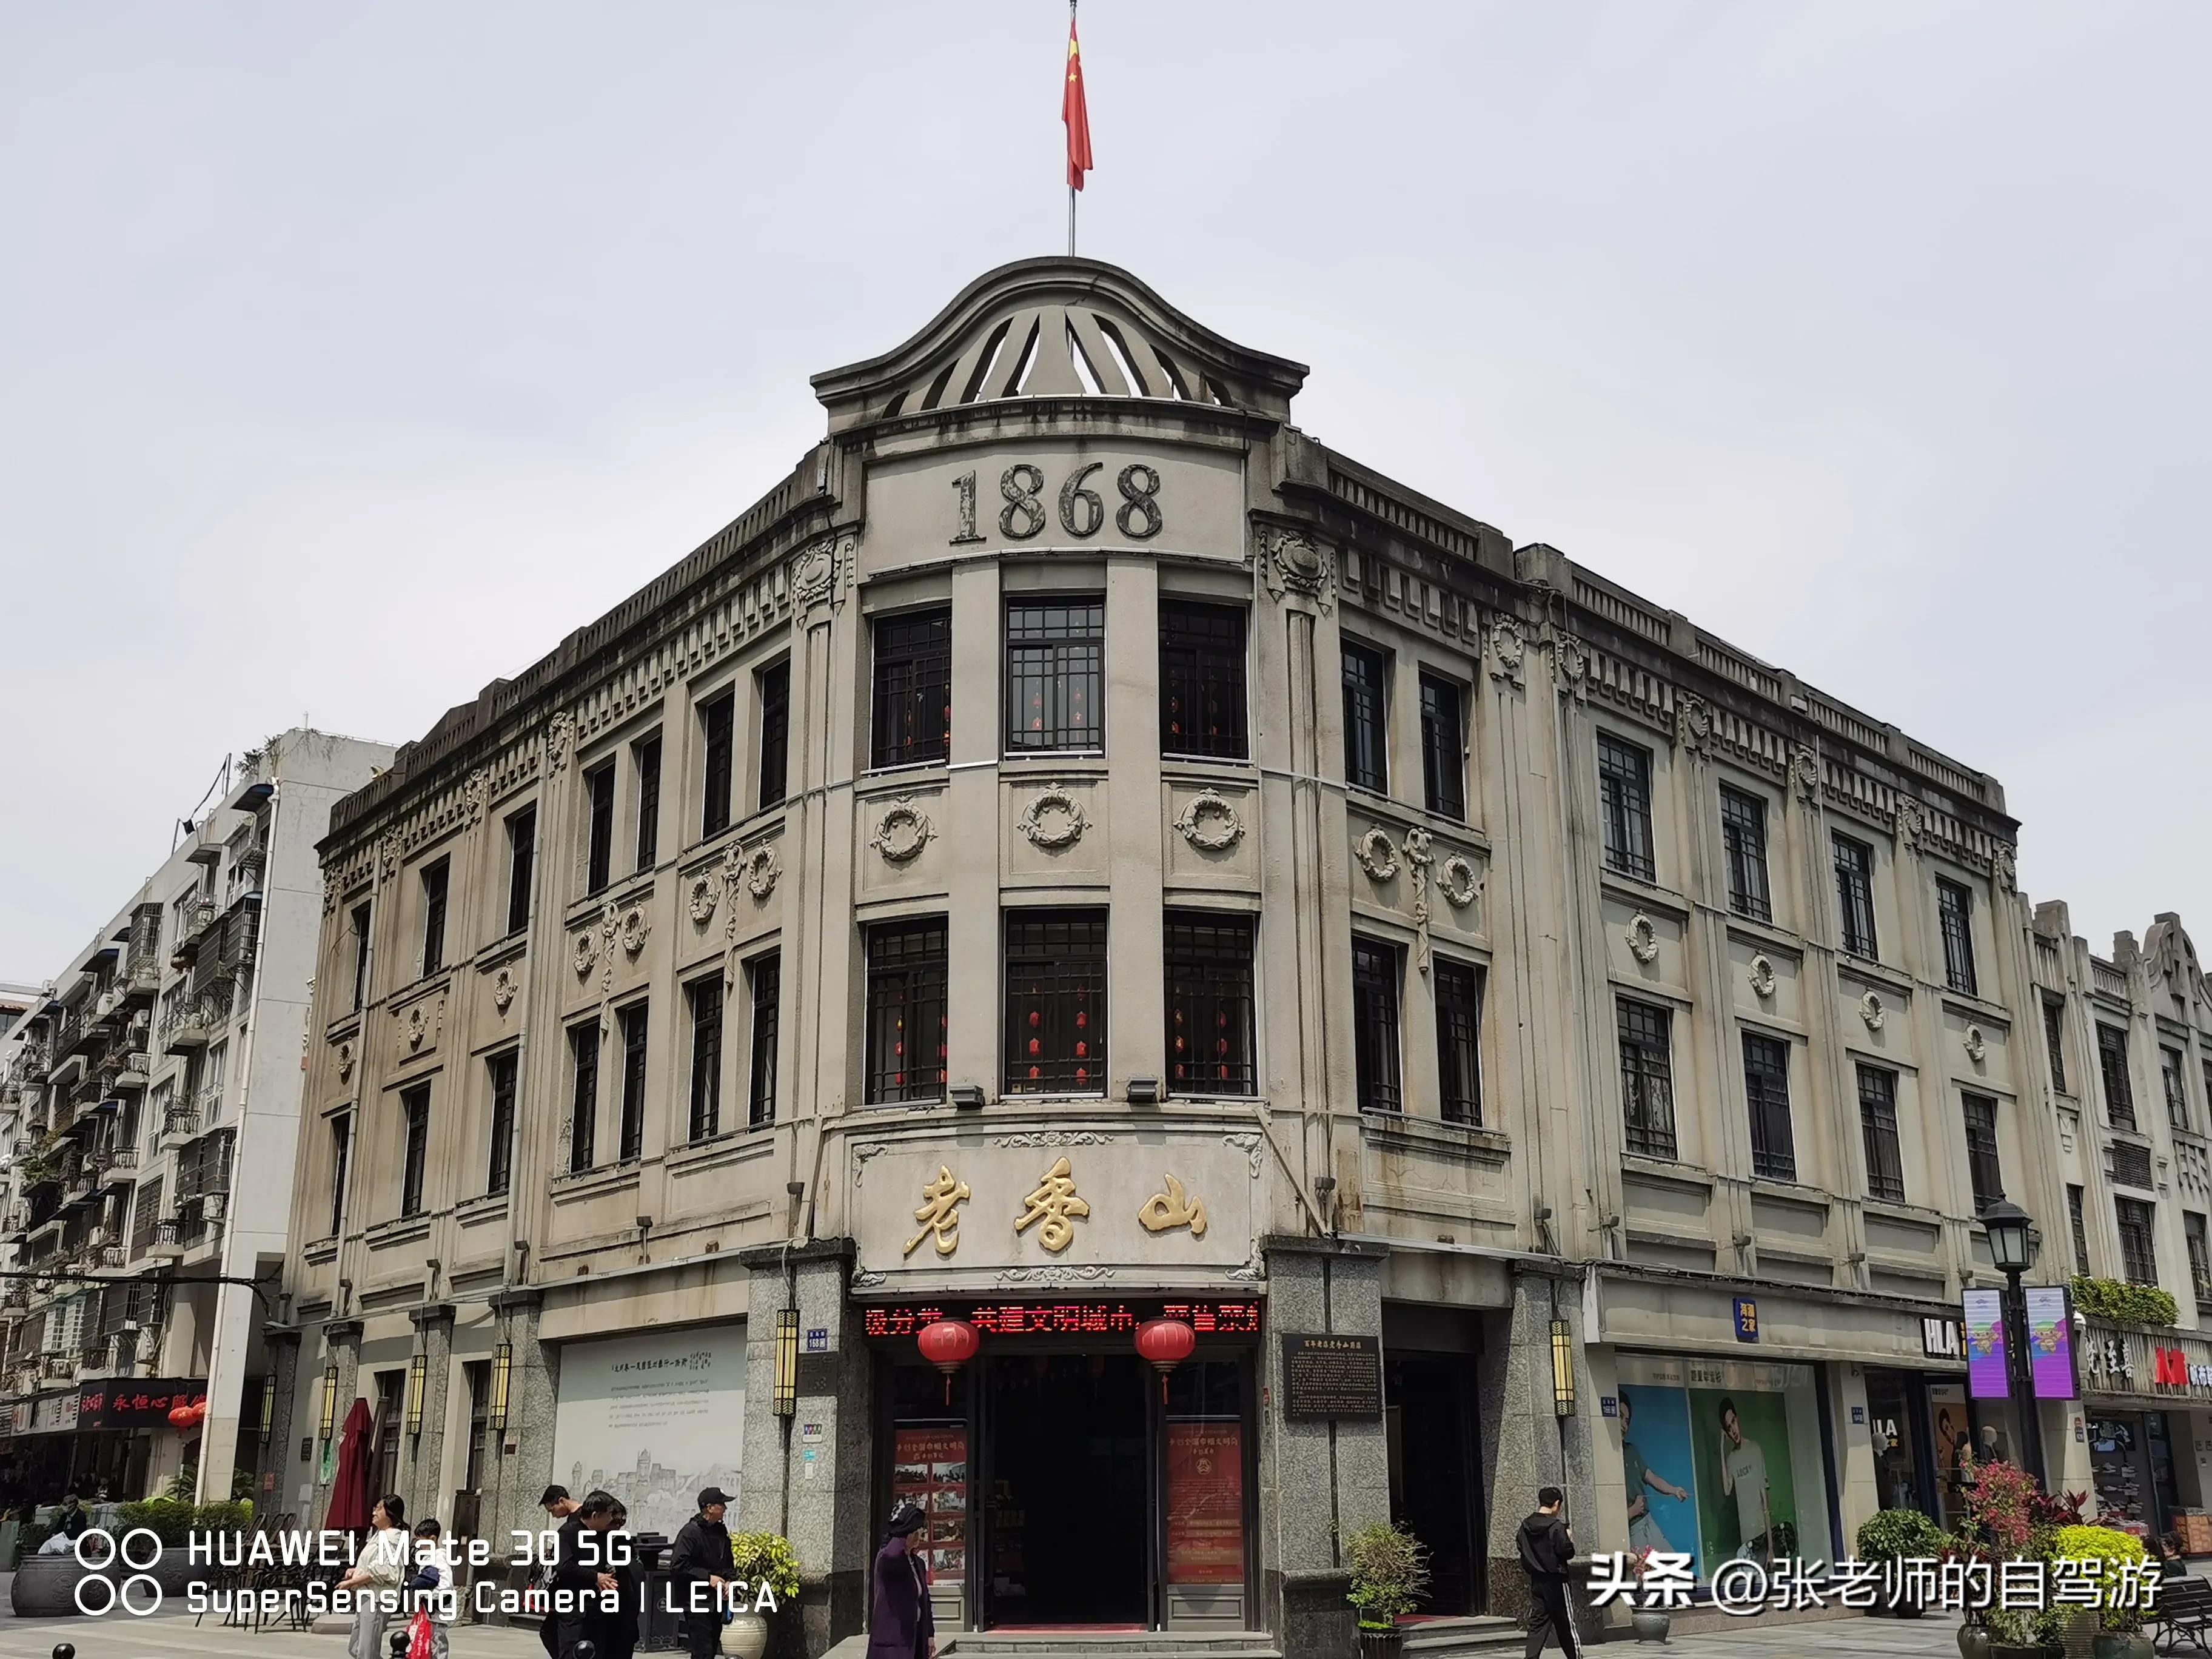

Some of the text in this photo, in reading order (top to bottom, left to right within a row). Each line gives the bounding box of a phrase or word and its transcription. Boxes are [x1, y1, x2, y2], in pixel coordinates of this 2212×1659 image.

[948, 462, 1163, 546] 1868
[902, 1156, 1208, 1255] 老香山
[1924, 1318, 1960, 1356] HLA
